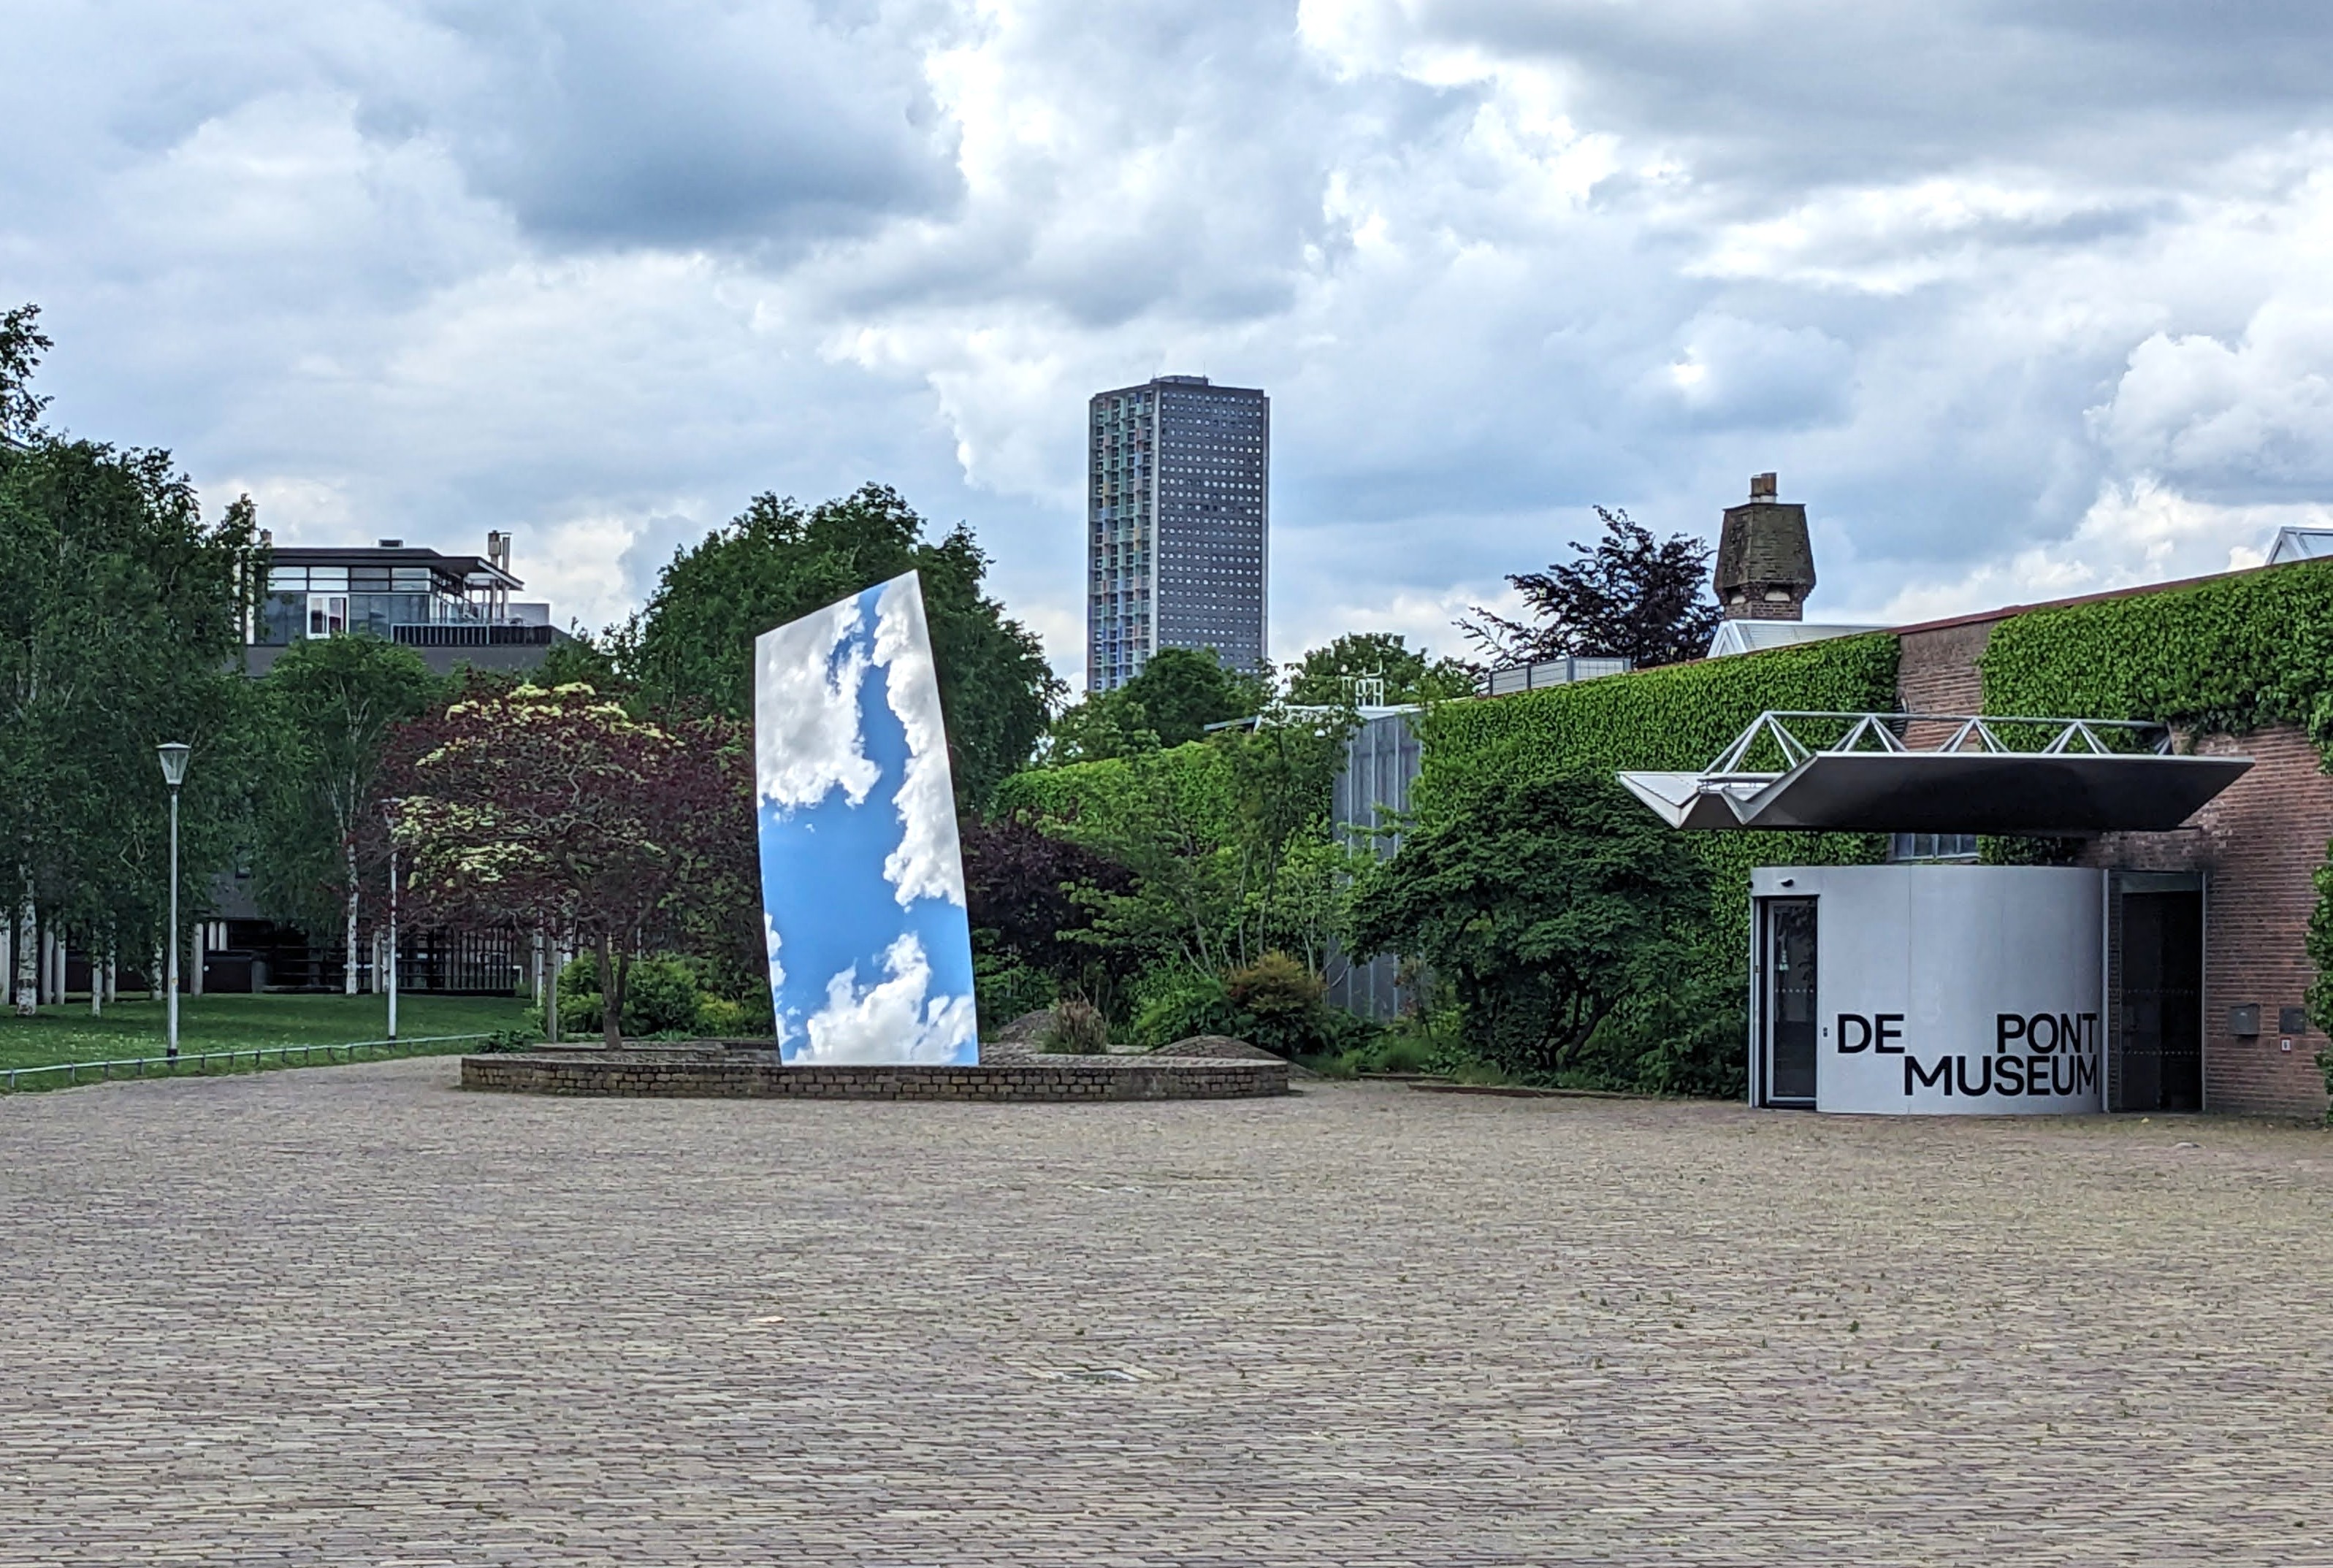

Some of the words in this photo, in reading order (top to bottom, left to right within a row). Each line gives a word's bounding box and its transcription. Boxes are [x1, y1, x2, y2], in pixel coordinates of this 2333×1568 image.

[1837, 1014, 1905, 1054] DE
[1997, 1013, 2097, 1054] PONT
[1904, 1055, 2097, 1096] MUSEUM
